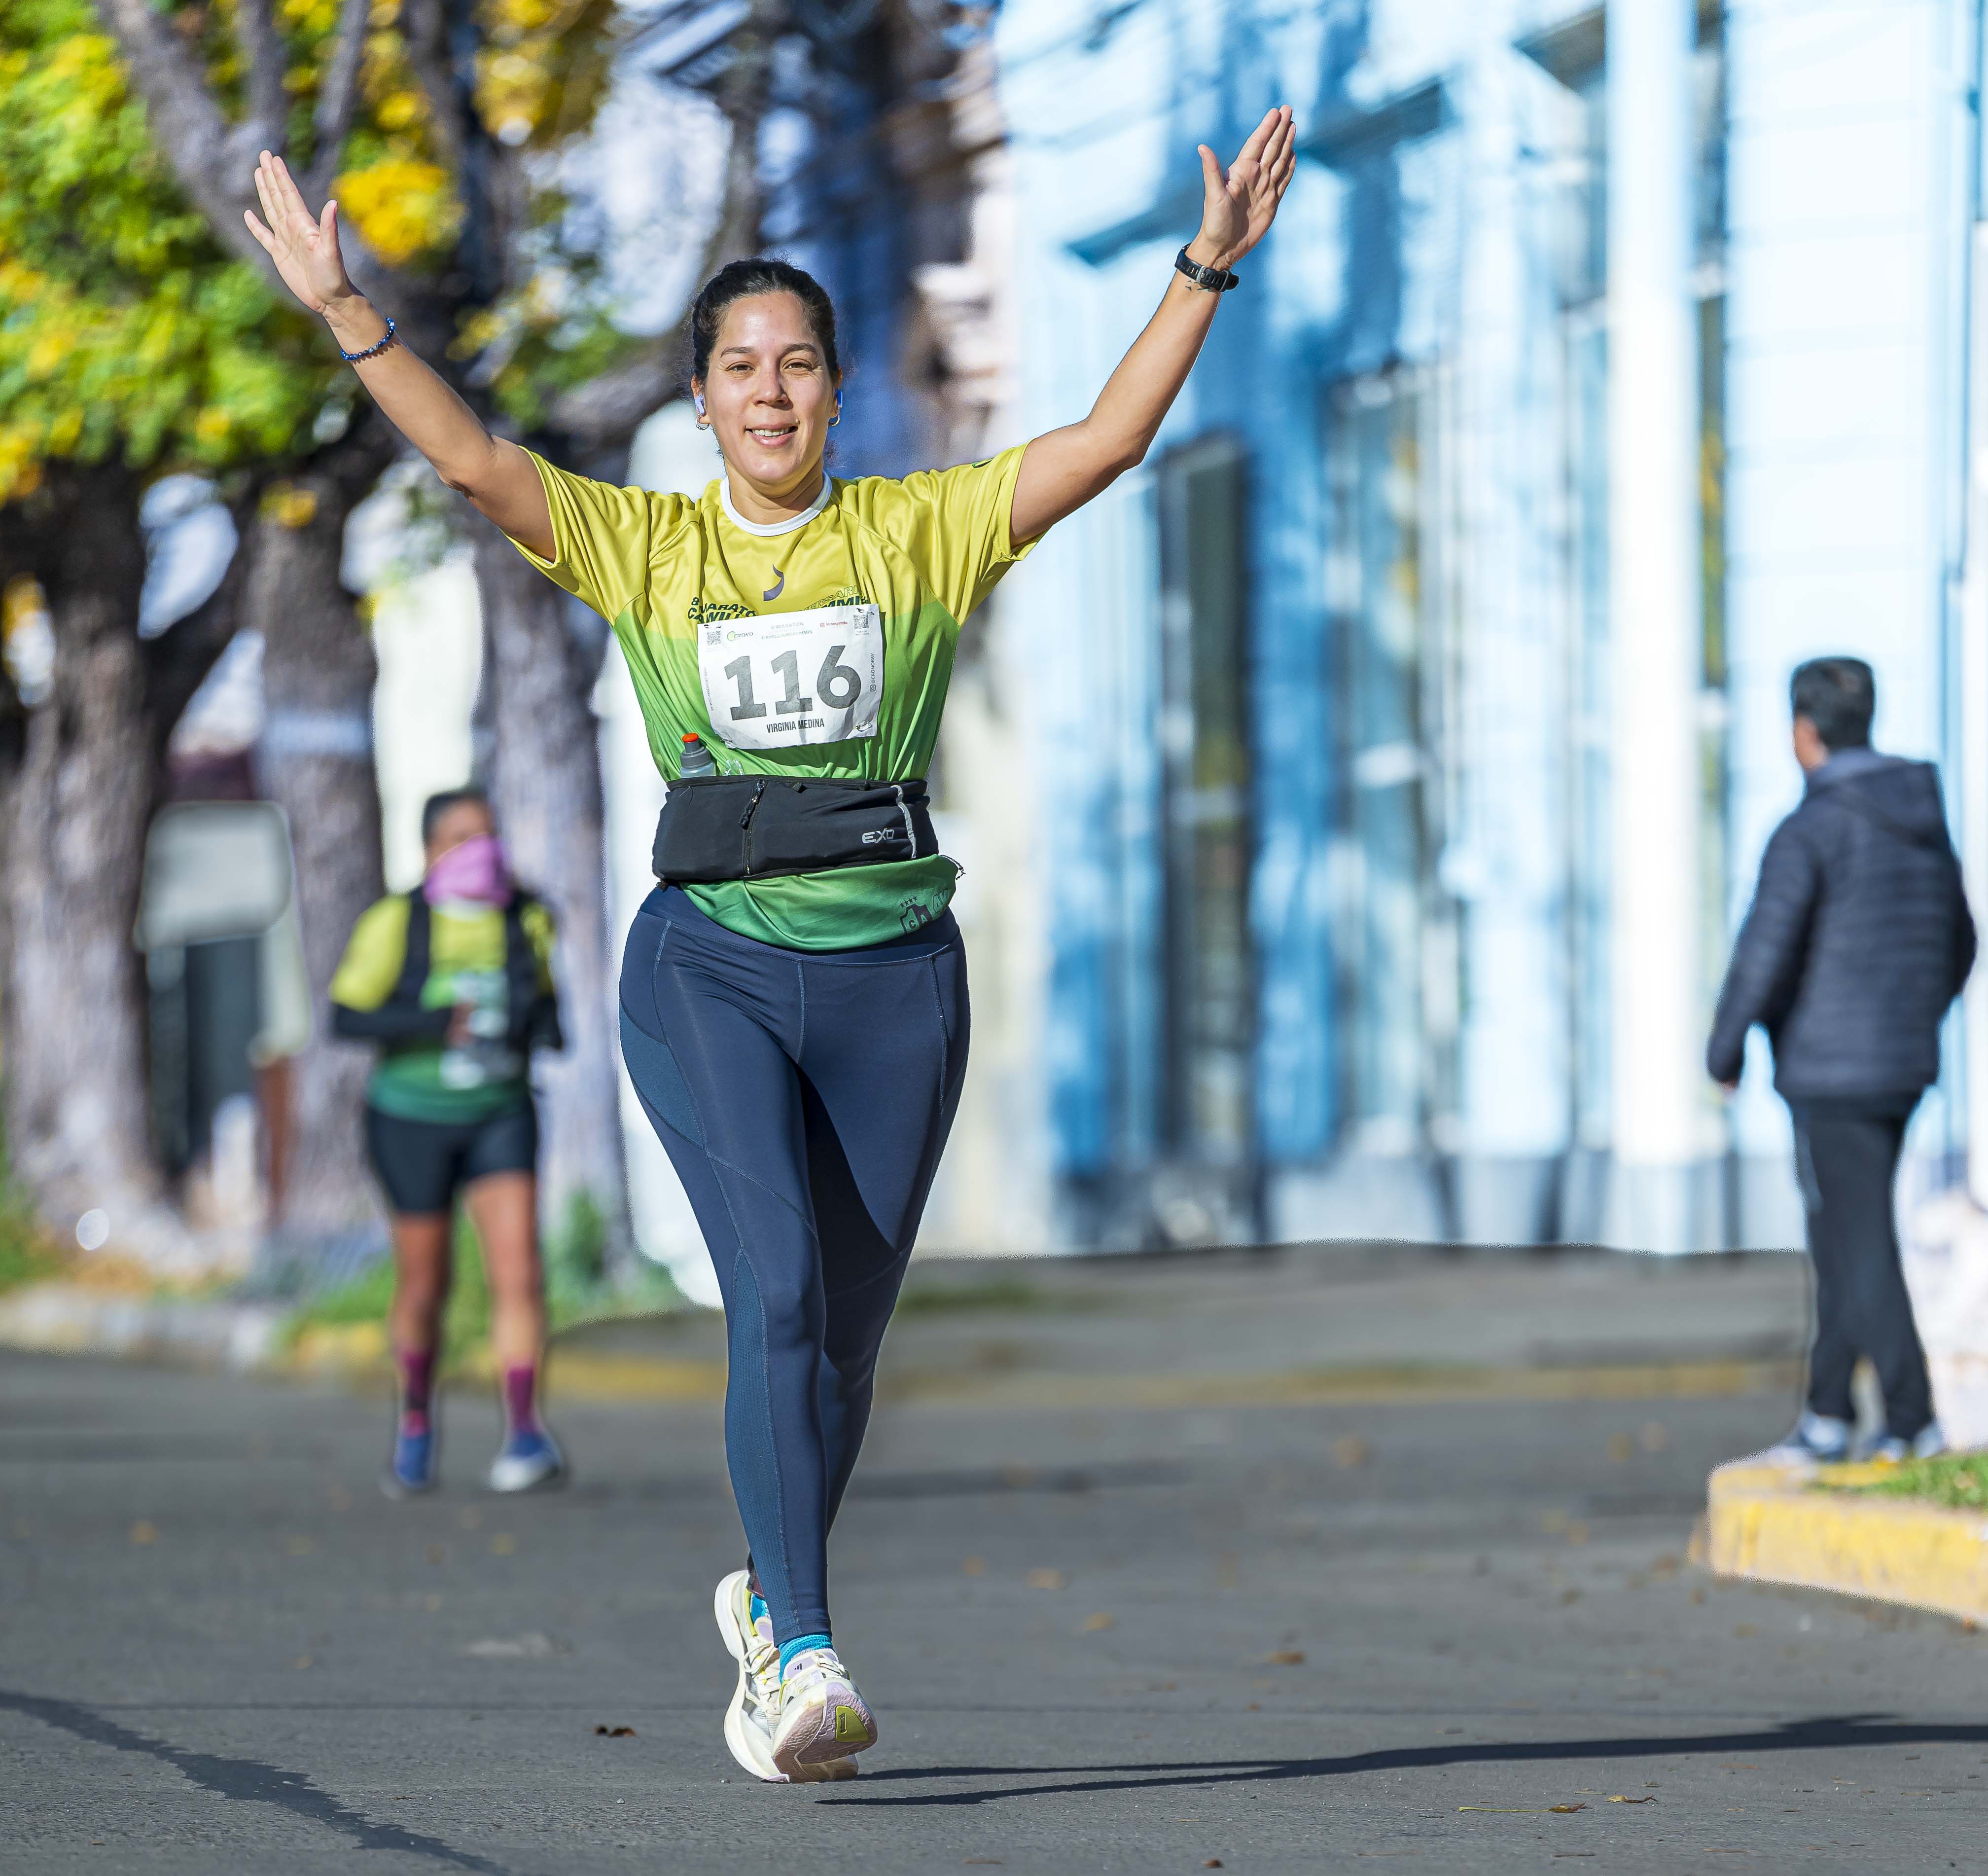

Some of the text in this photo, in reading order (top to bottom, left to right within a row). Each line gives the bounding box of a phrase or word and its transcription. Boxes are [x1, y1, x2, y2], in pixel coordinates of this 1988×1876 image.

[724, 645, 861, 721] 116
[766, 718, 825, 733] VIRGINIA MEDINA
